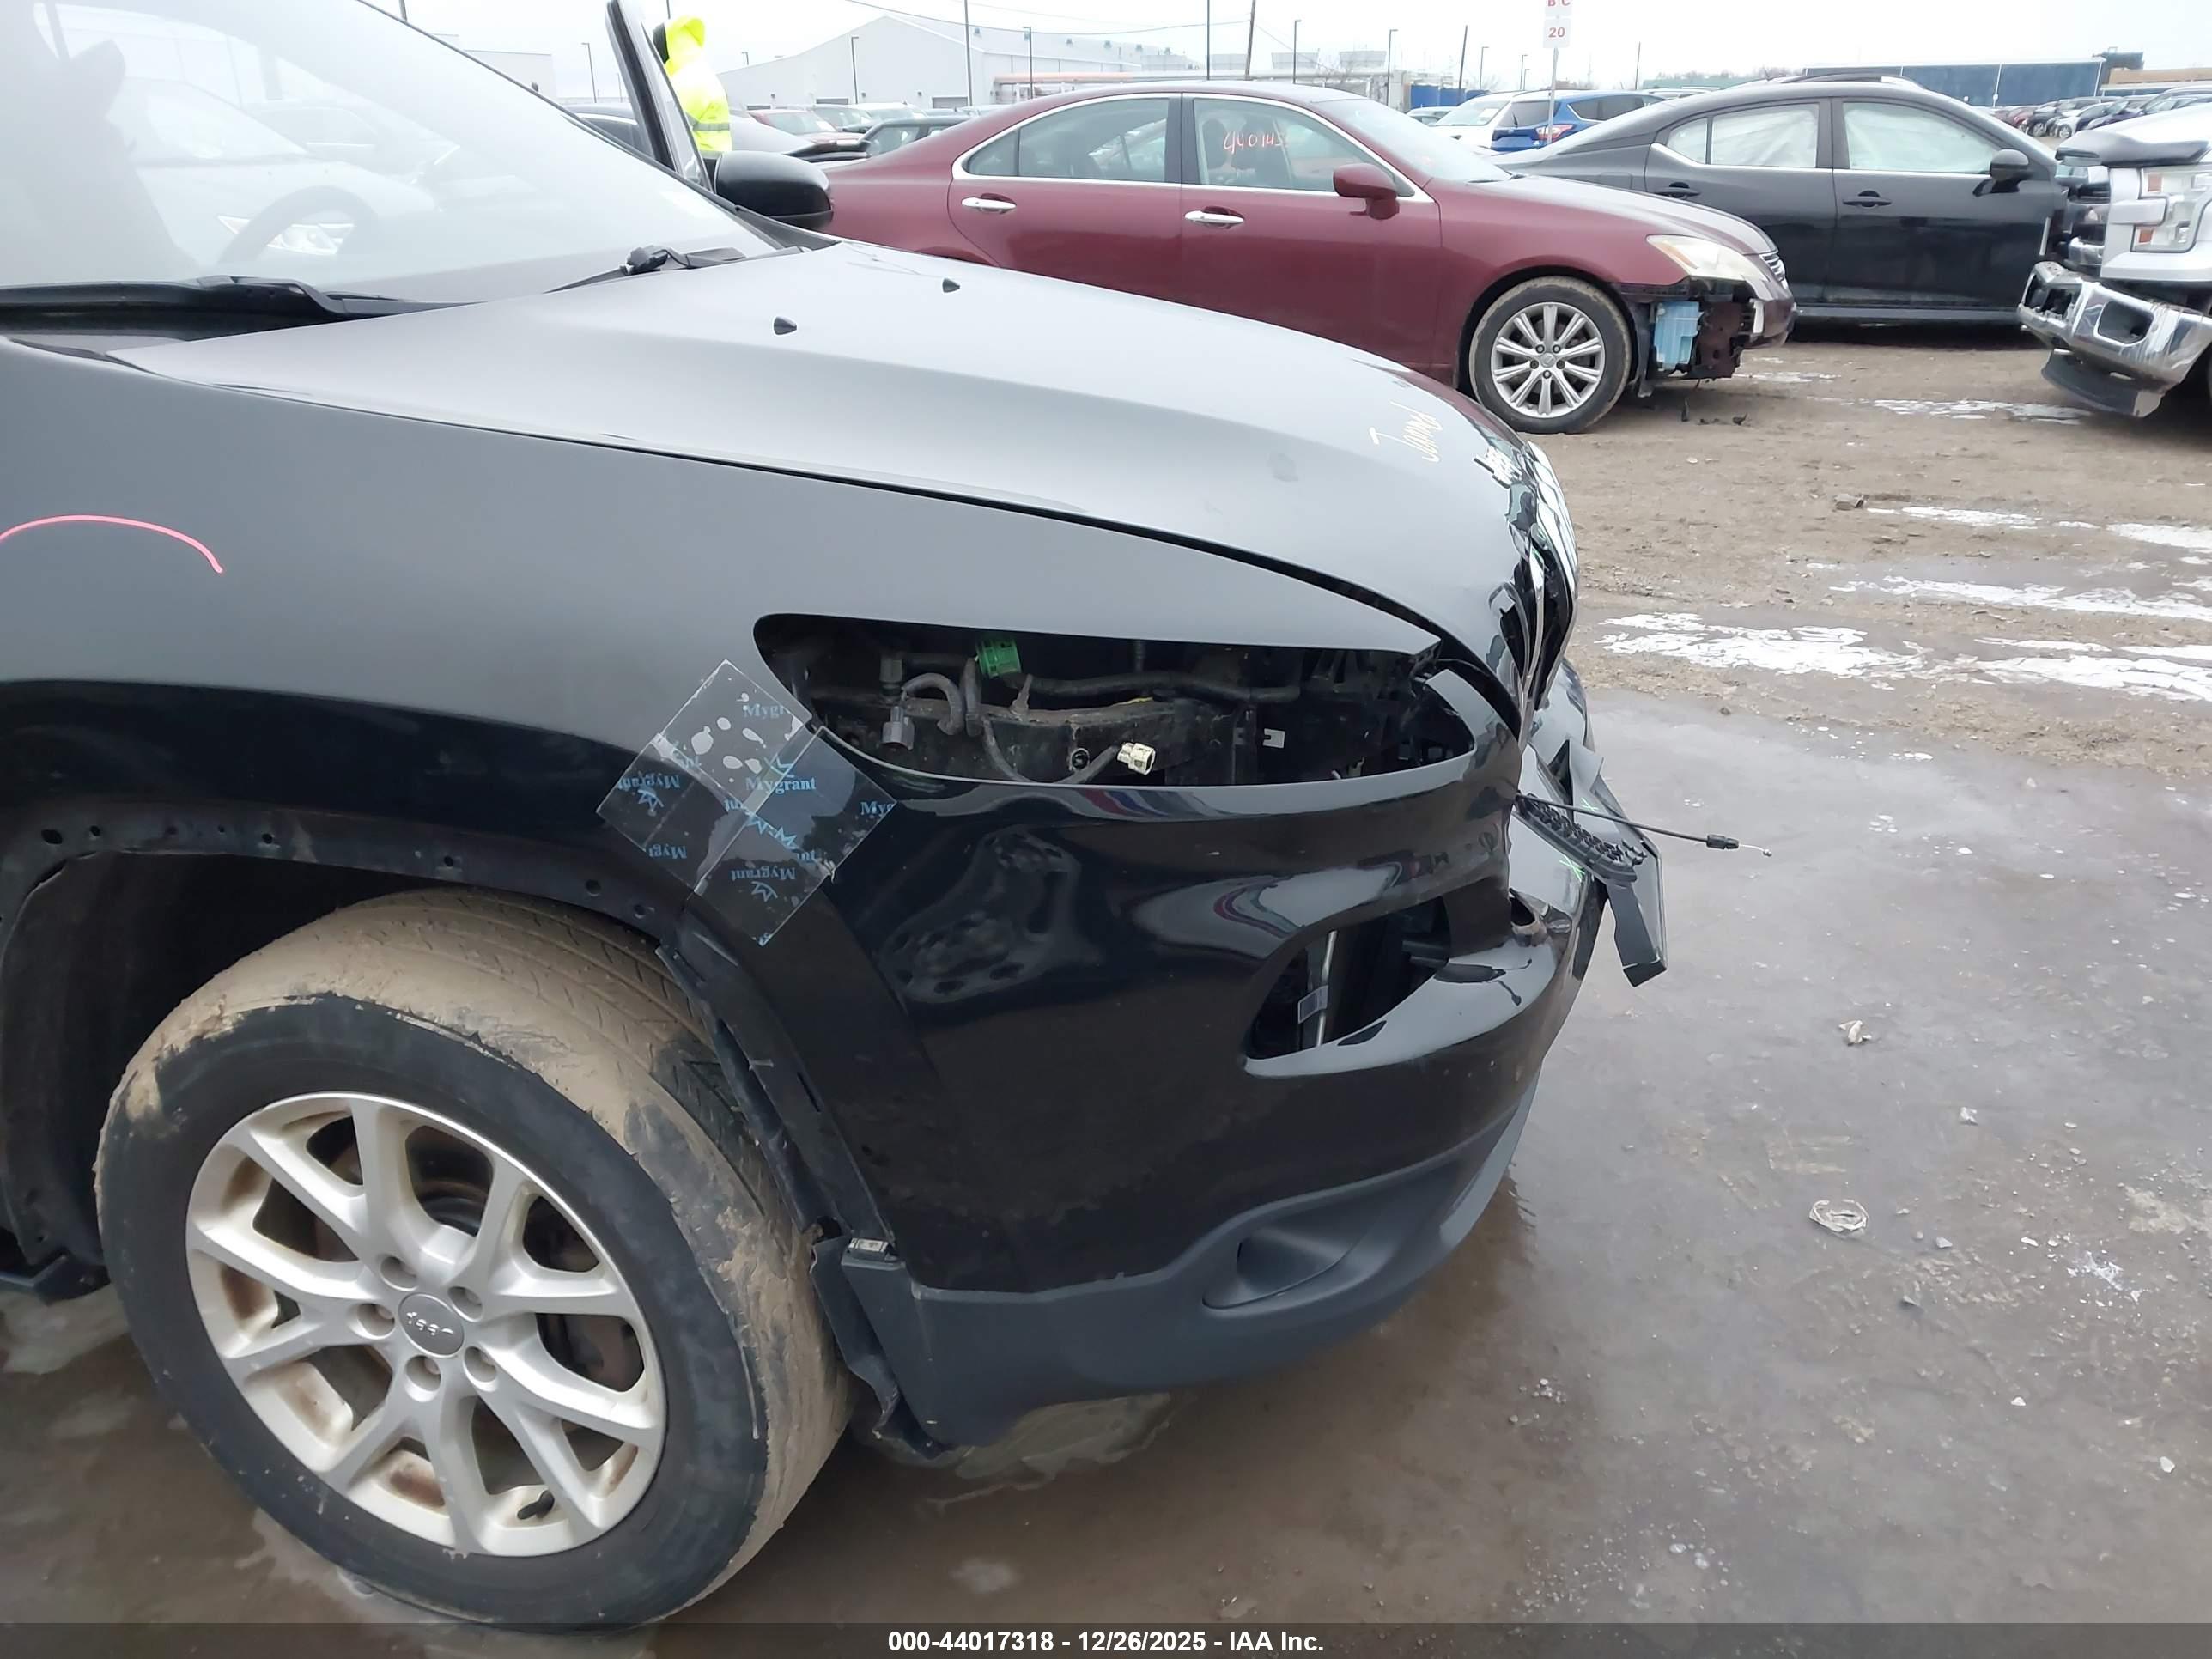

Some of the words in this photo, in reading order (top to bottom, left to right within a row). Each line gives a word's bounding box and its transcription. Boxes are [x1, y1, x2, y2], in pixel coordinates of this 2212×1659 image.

[1548, 27, 1565, 38] 20
[745, 776, 816, 794] Mygrant
[731, 865, 796, 881] Mygrant
